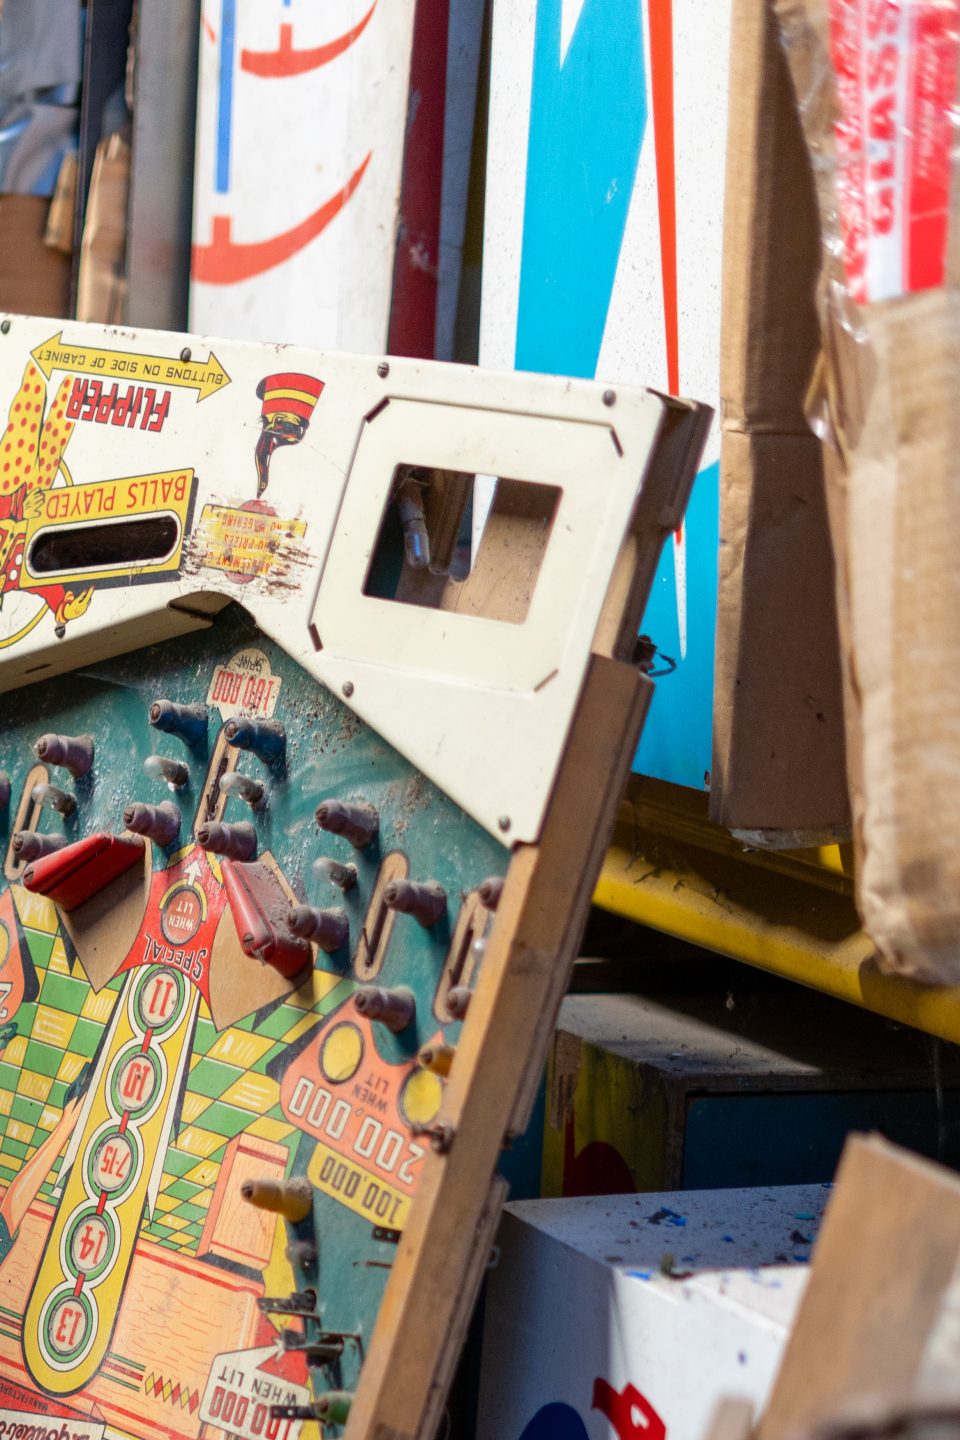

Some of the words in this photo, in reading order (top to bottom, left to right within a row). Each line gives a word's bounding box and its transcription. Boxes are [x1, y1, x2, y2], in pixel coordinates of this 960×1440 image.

[38, 350, 86, 366] CABINET
[90, 357, 106, 369] OF
[110, 359, 138, 373] SIDE
[143, 363, 161, 376] ON
[166, 367, 223, 385] BUTTONS
[65, 377, 172, 433] FLIPPER
[46, 486, 117, 519] PLAYED
[126, 474, 187, 508] BALLS
[168, 914, 194, 931] WHEN
[176, 900, 193, 914] LIT
[142, 932, 208, 981] SPECIAL
[149, 979, 174, 1017] 11
[123, 1063, 150, 1102] 10
[363, 1073, 389, 1095] LIT
[352, 1083, 388, 1115] WHEN
[288, 1076, 425, 1185] 200,000
[319, 1156, 402, 1225] 100,000
[79, 1225, 106, 1265] 14
[55, 1307, 82, 1346] 13
[217, 1365, 245, 1389] LIT
[251, 1377, 298, 1407] WHEN
